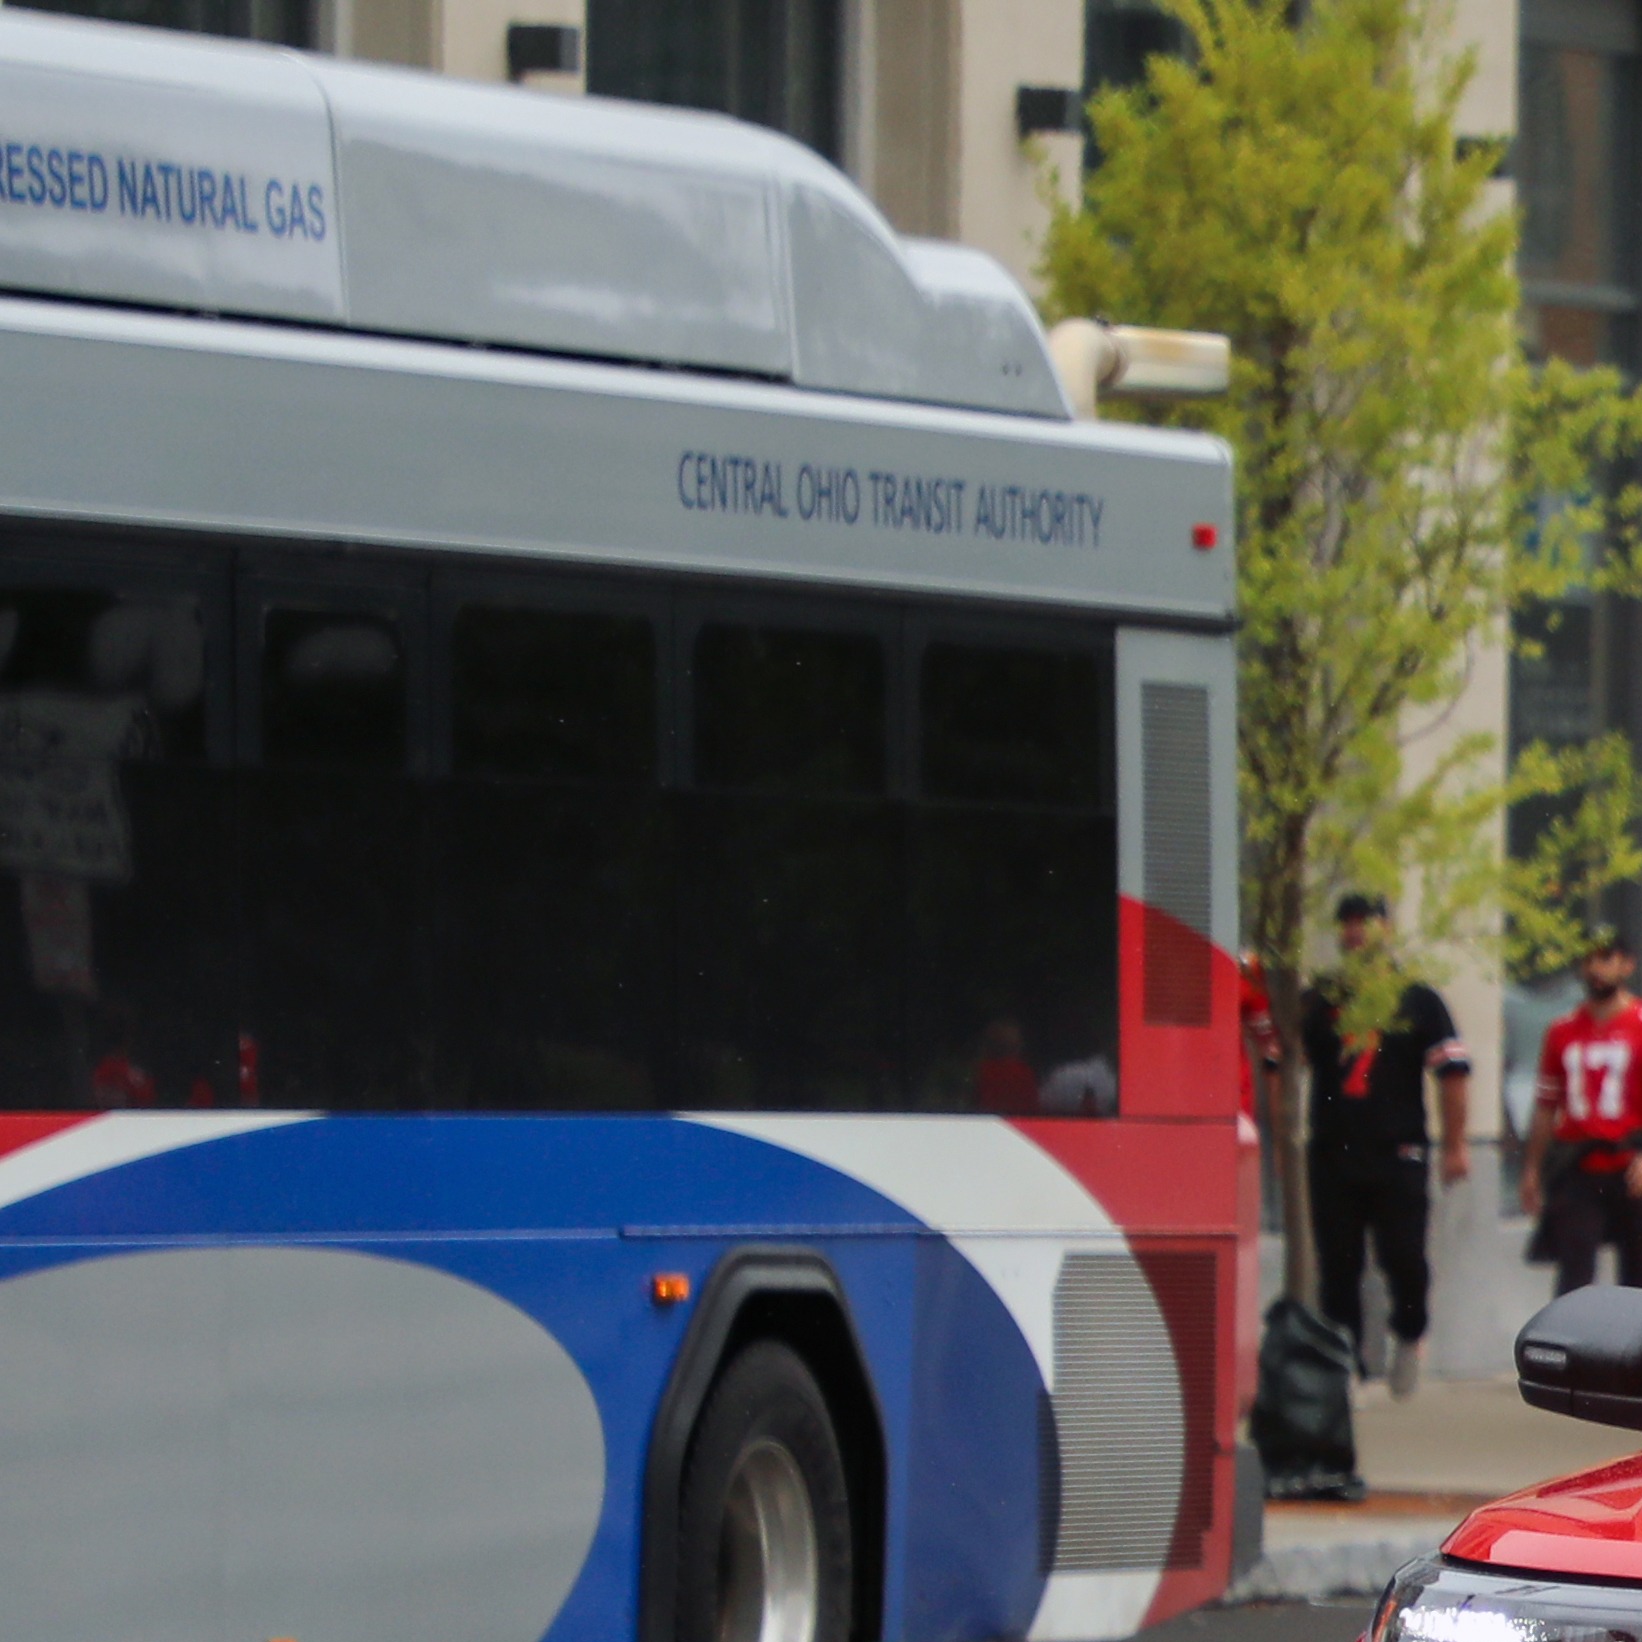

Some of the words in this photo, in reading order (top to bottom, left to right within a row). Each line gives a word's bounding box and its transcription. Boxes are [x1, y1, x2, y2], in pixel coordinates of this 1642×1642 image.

[0, 144, 108, 213] ESSED
[117, 156, 258, 233] NATURAL
[265, 178, 326, 242] GAS
[678, 451, 788, 518] CENTRAL
[799, 464, 860, 525] OHIO
[869, 471, 966, 535] TRANSIT
[975, 484, 1105, 547] AUTHORITY
[1562, 1040, 1630, 1119] 17
